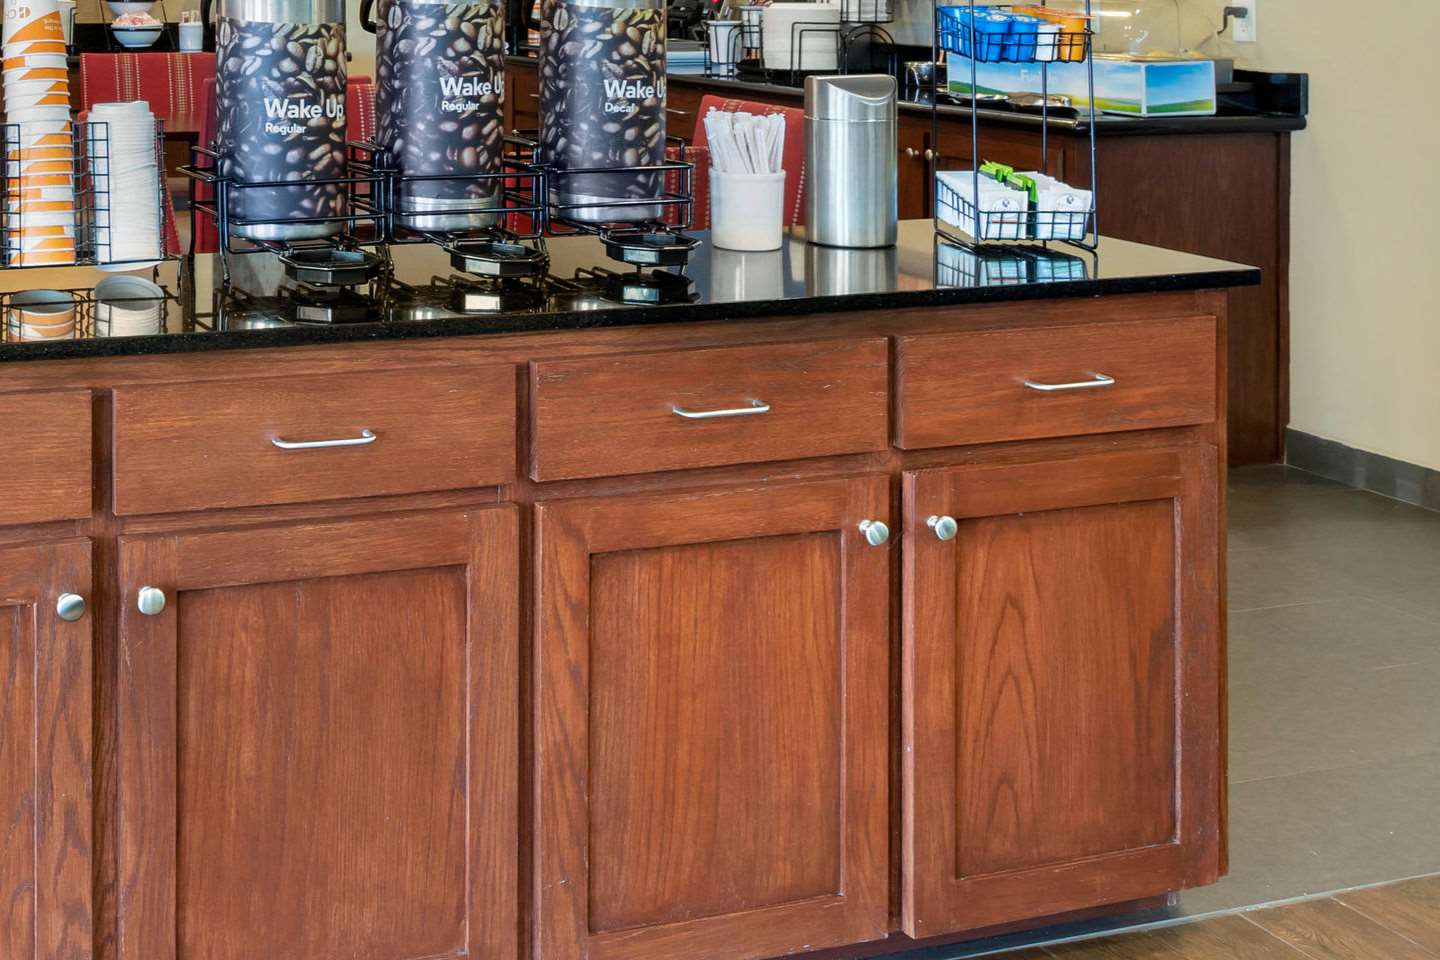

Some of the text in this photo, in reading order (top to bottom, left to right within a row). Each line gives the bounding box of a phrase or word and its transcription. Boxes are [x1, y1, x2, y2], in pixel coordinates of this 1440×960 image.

[439, 75, 506, 99] Wake U
[603, 79, 667, 99] Wake U
[263, 97, 345, 123] Wake Up
[441, 100, 480, 113] Regular
[604, 102, 636, 113] Decaf
[264, 122, 307, 136] Regular
